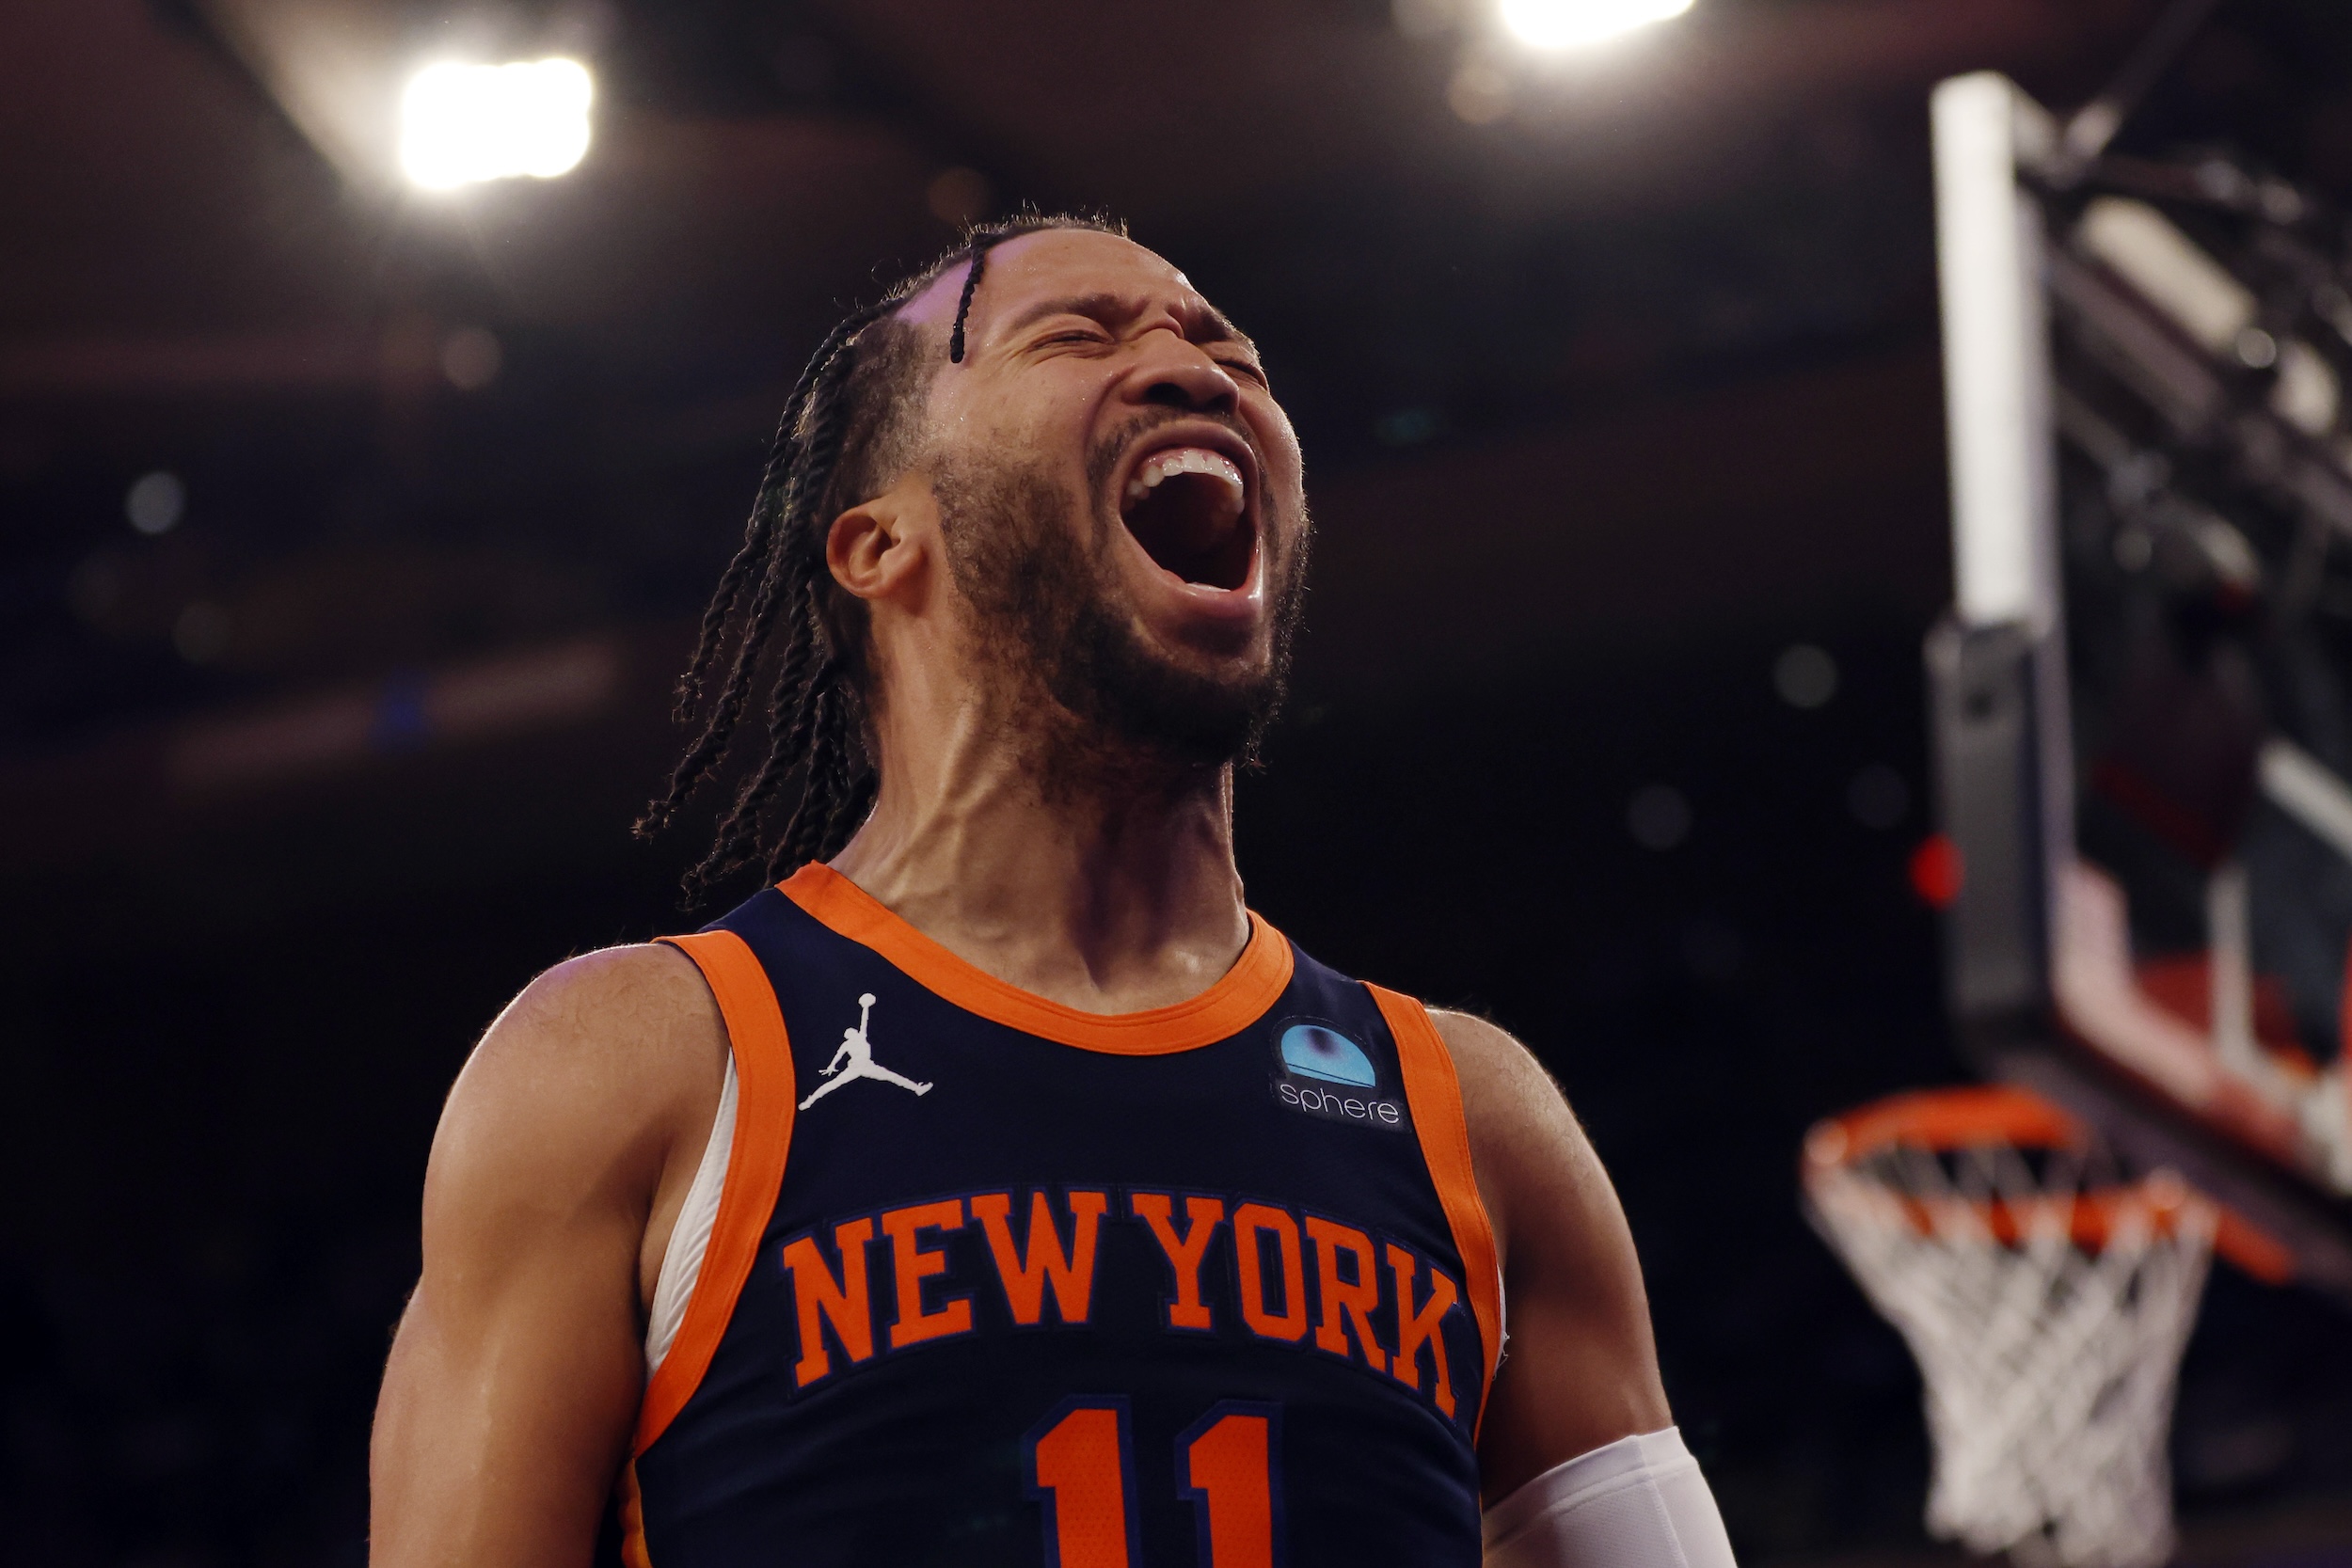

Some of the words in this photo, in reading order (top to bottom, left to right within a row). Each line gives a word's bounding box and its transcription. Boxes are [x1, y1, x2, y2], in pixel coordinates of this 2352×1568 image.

[1279, 1084, 1400, 1124] sphere
[782, 1191, 1107, 1389] NEW
[1132, 1192, 1458, 1422] YORK
[1031, 1406, 1276, 1568] 11
